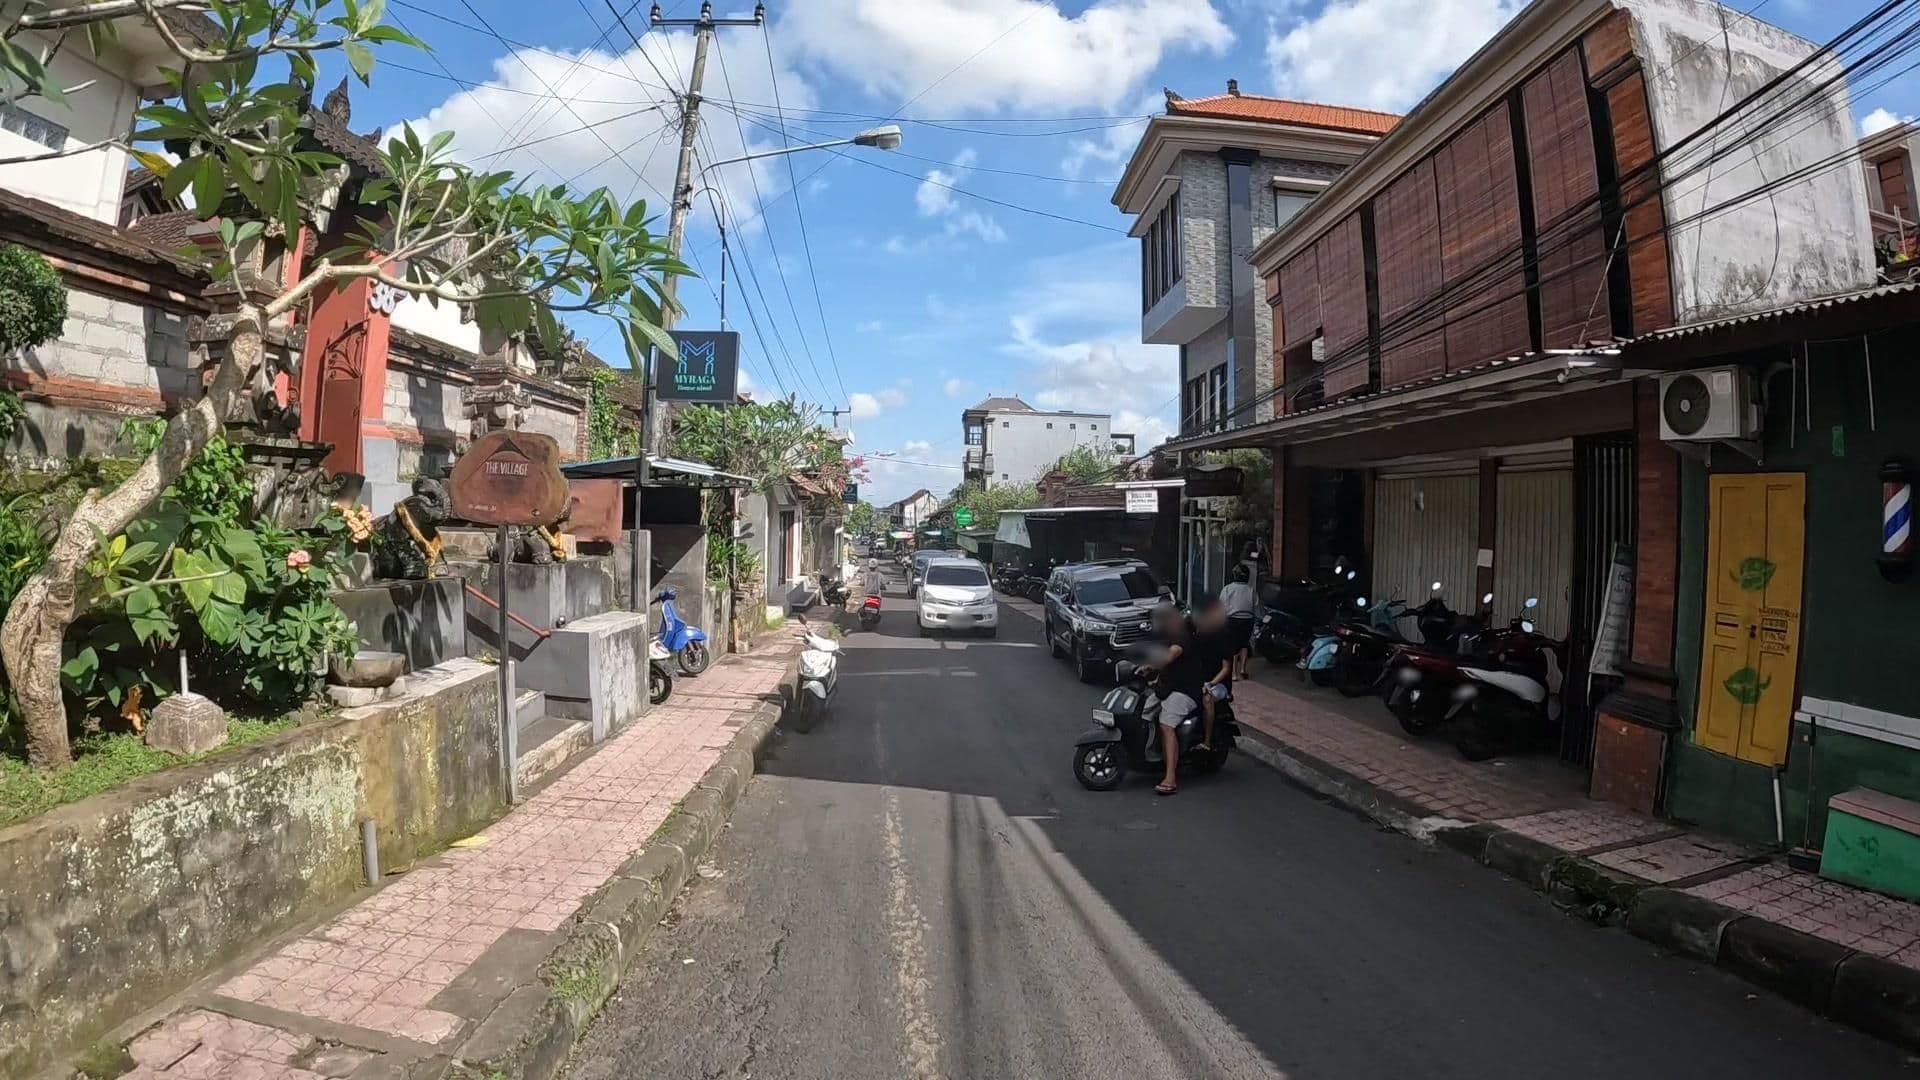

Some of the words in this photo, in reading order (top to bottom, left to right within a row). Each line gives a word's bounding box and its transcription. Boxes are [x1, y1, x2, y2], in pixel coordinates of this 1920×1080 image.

[673, 374, 716, 385] MYRAGA
[485, 461, 498, 473] THE
[500, 462, 529, 475] VILLAGE
